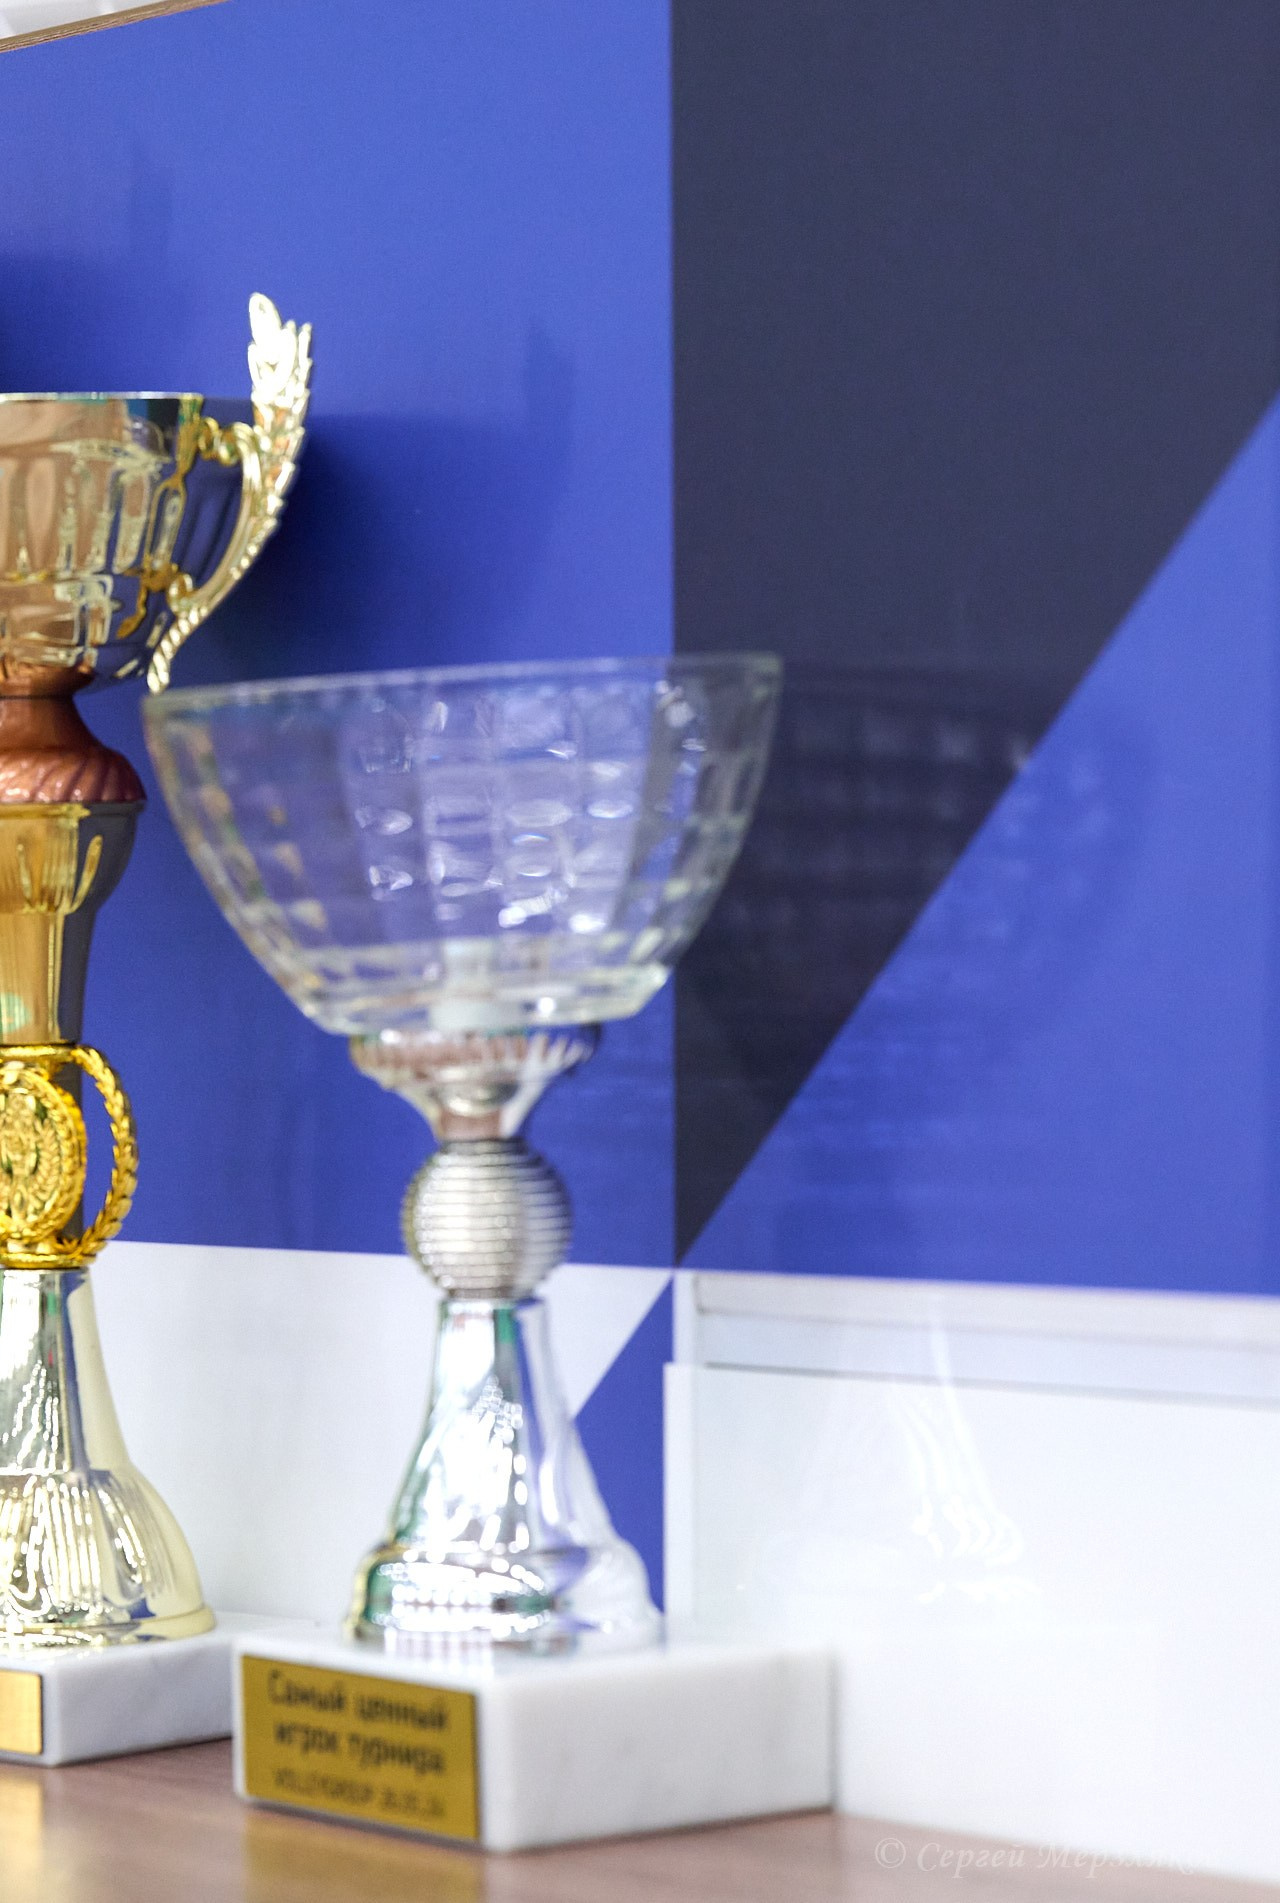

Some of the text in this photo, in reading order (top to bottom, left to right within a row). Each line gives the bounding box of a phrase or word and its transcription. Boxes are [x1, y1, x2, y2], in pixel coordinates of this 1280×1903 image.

[267, 1668, 448, 1731] Самый ценный
[275, 1721, 446, 1777] игрок турнира
